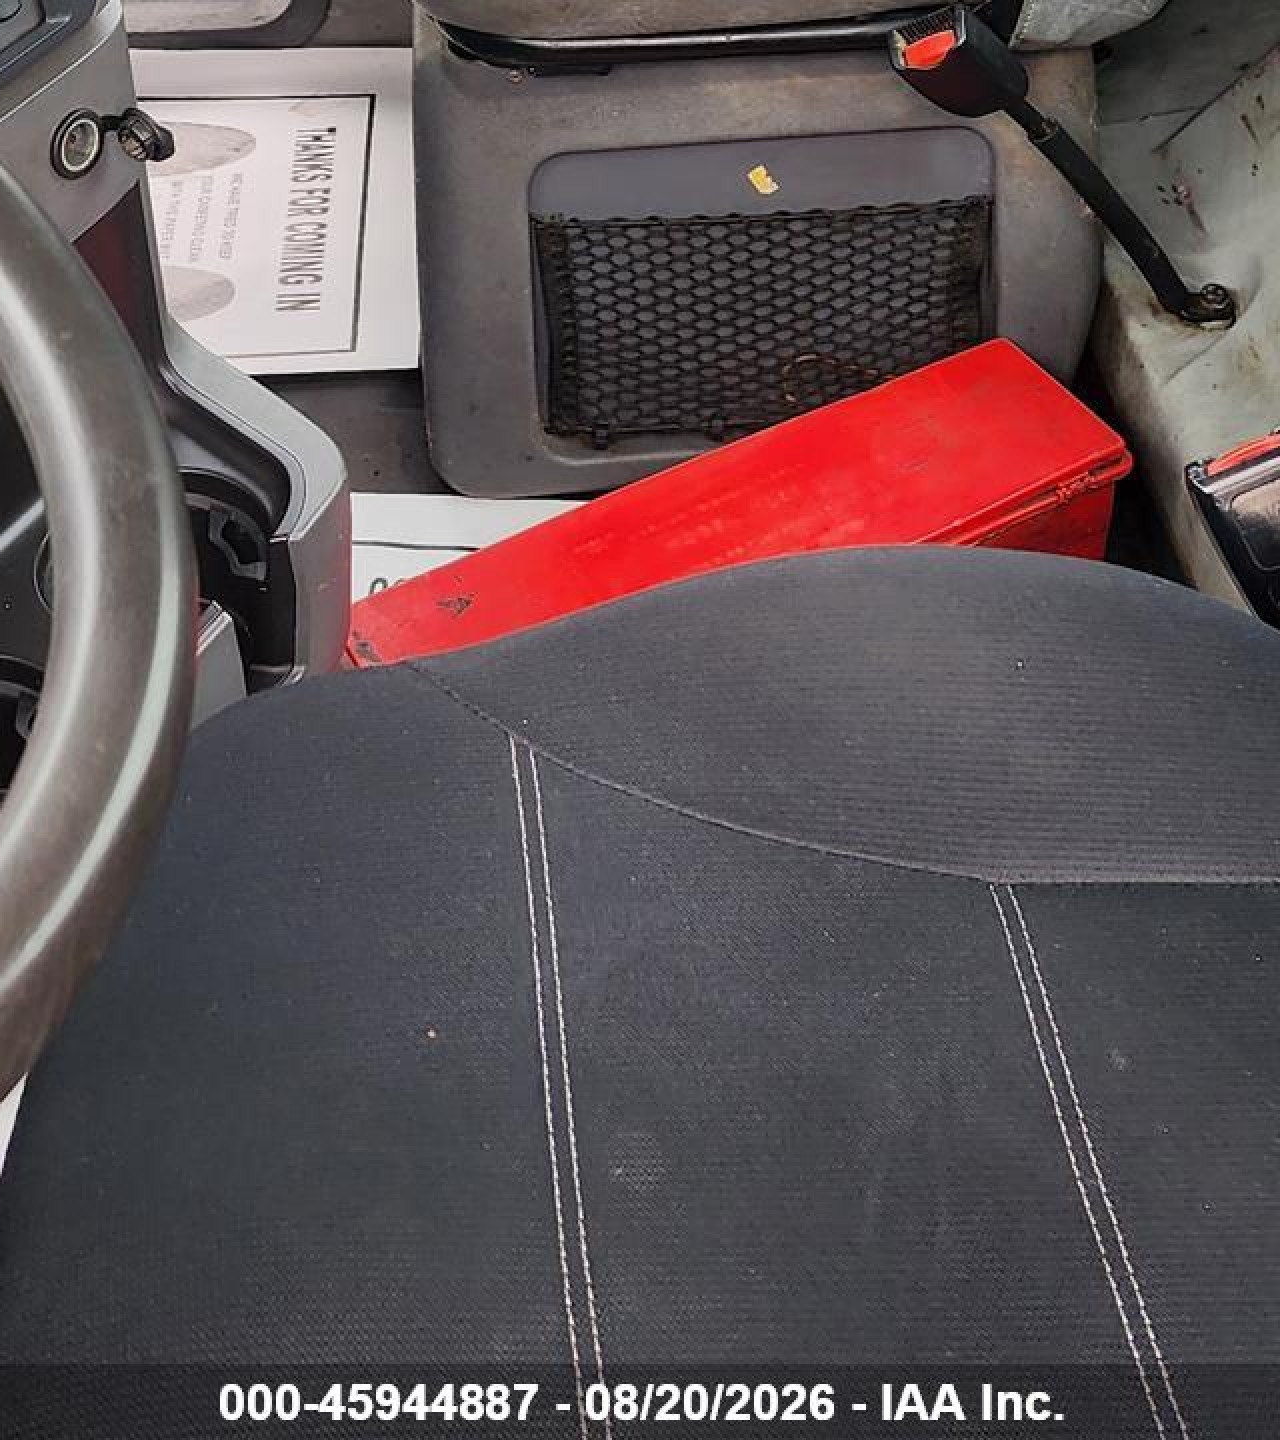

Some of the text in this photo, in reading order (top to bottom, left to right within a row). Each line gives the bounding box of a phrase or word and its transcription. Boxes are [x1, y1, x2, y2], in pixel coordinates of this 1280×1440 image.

[275, 127, 337, 311] THANKS FOR COMING IN
